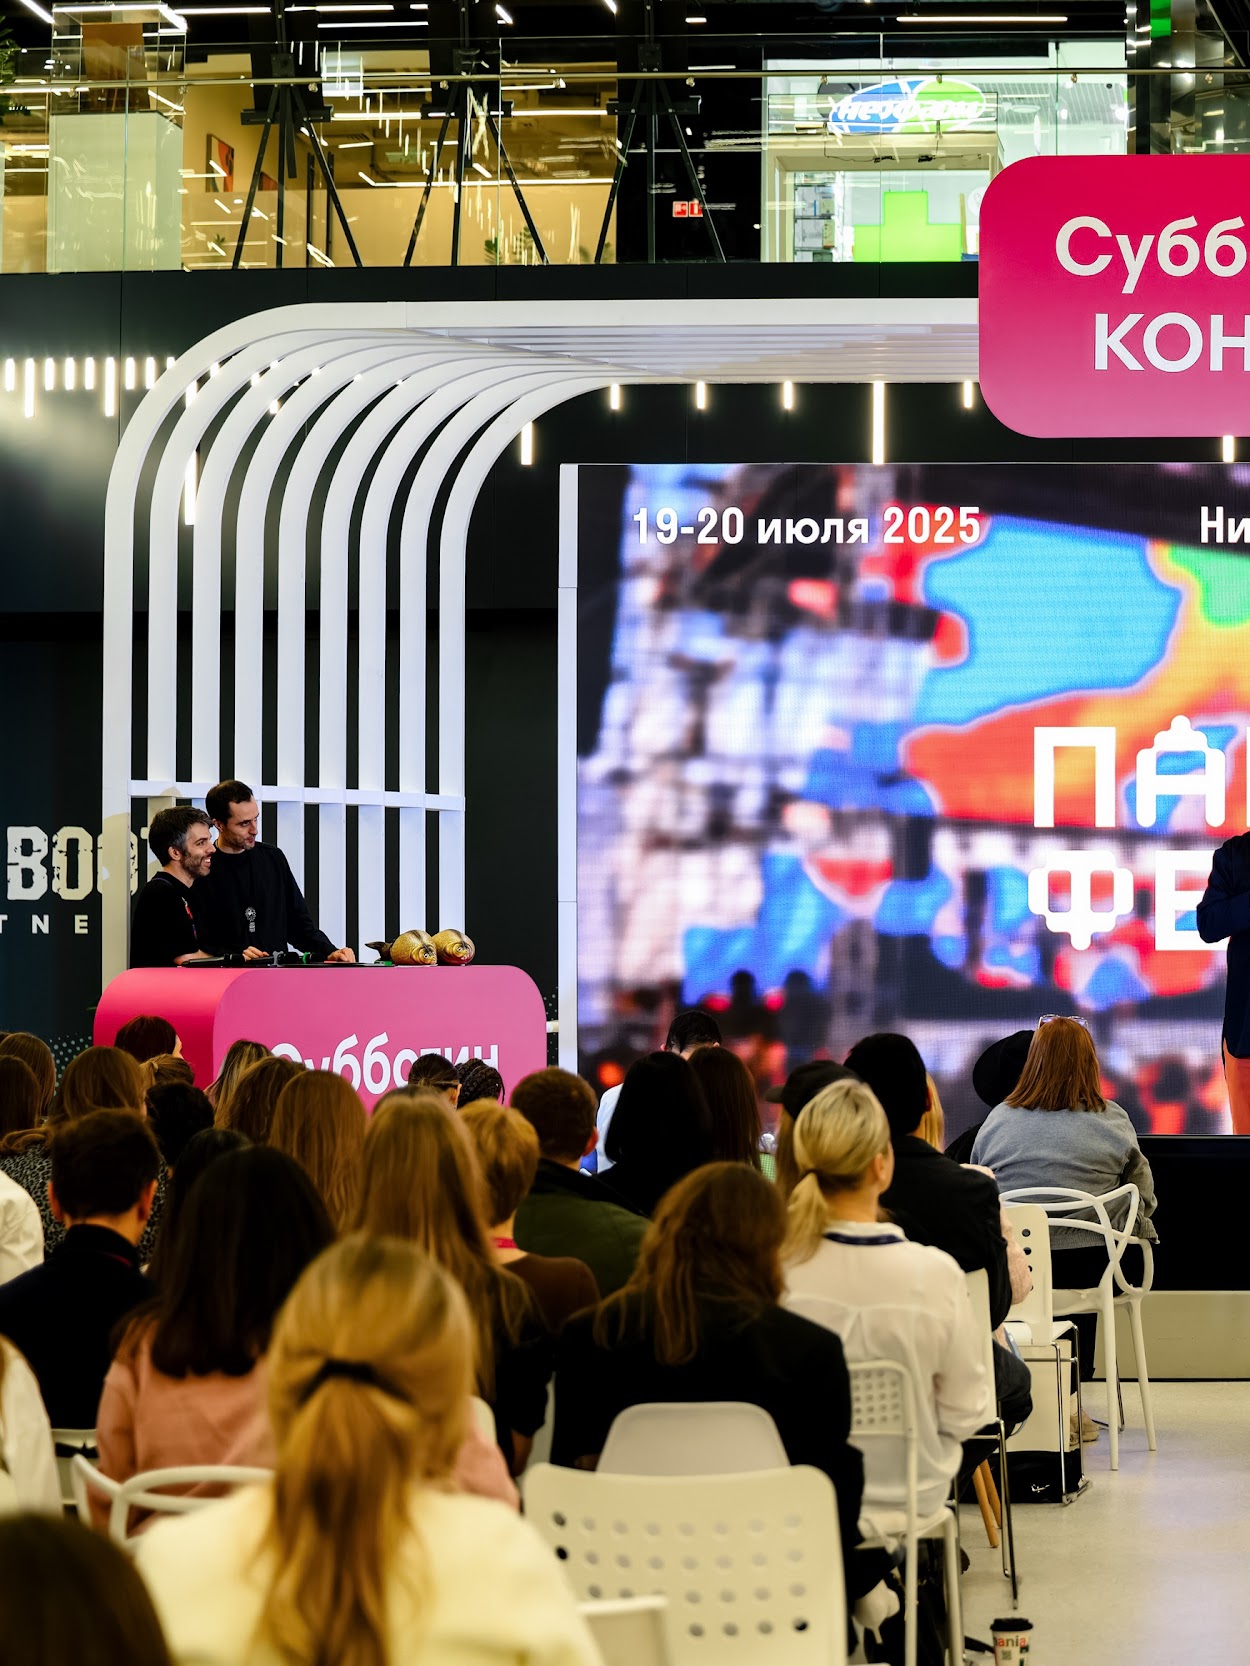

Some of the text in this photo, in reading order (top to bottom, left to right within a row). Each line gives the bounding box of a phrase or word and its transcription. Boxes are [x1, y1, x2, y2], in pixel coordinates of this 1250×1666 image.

[633, 505, 981, 545] 19-20 июля 2025
